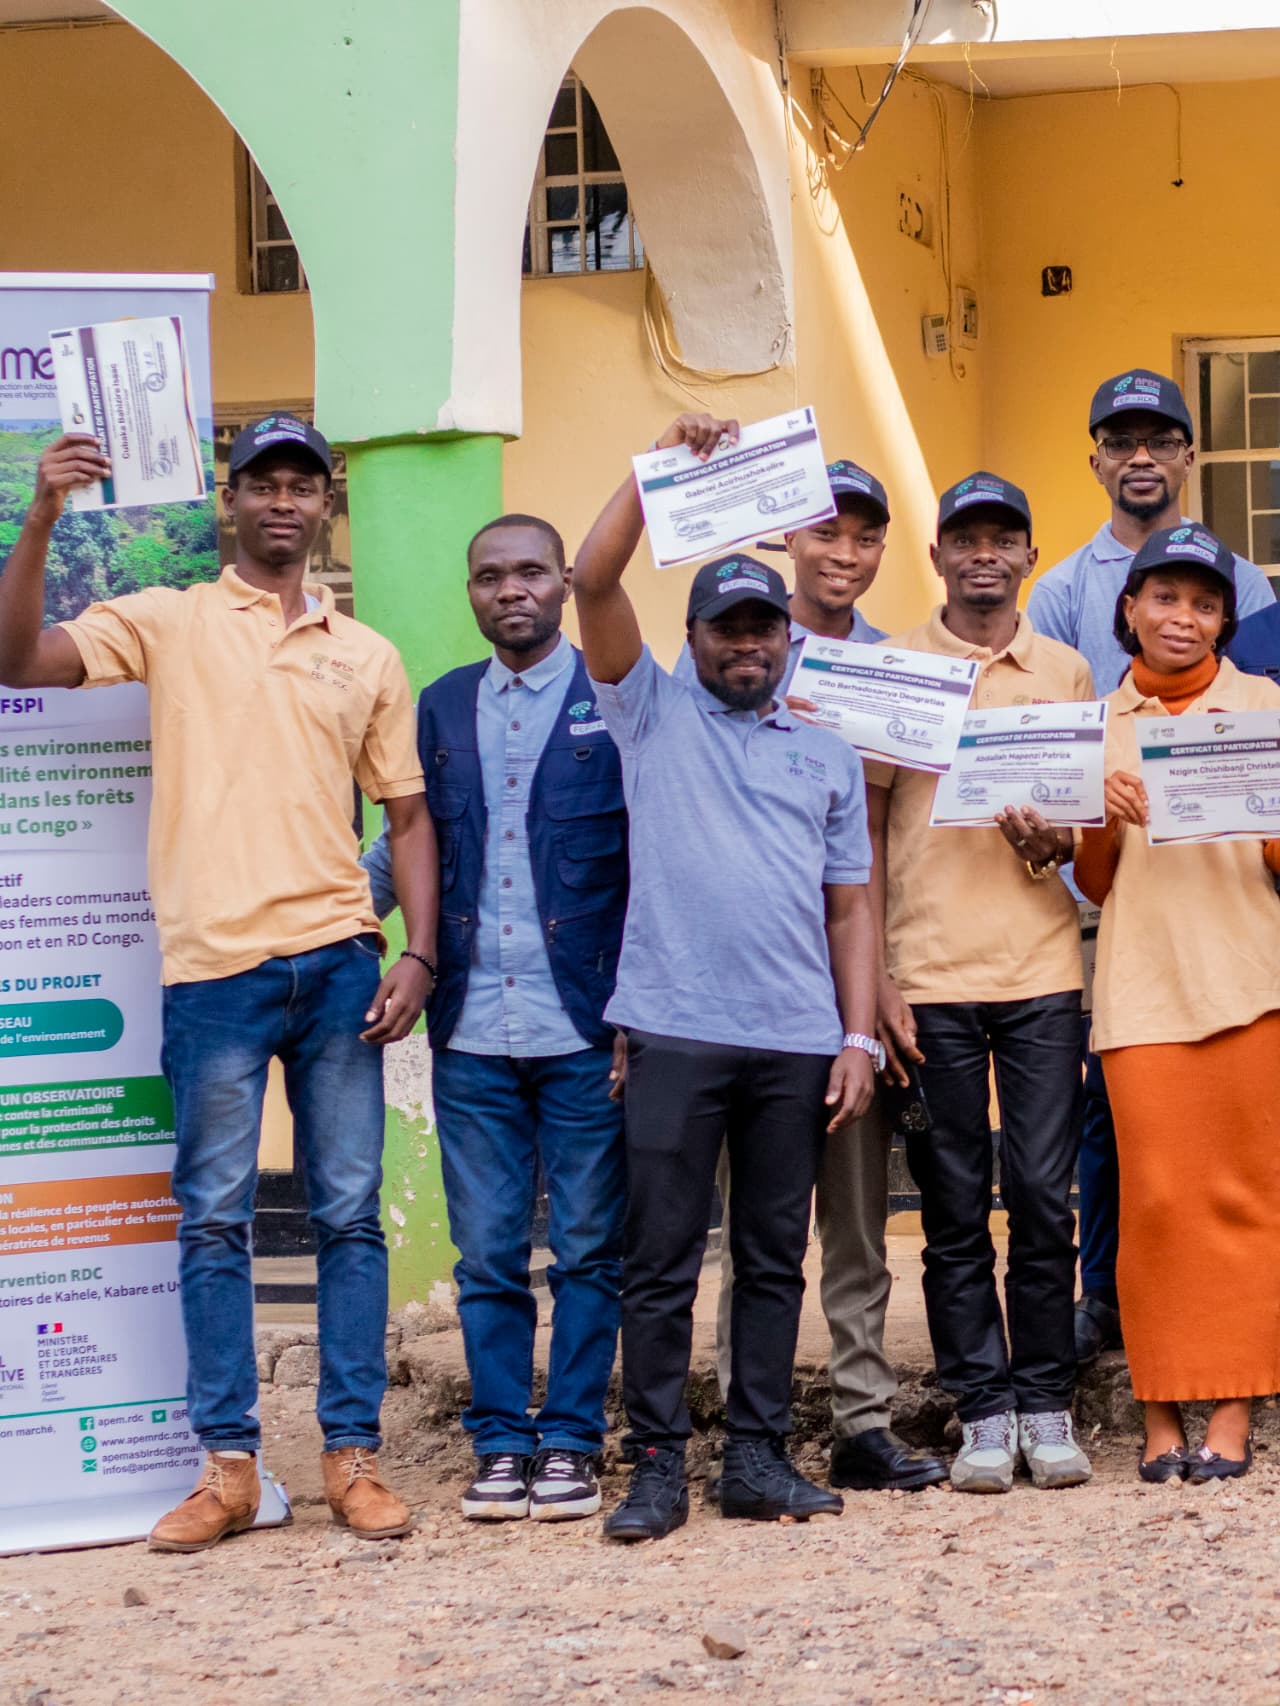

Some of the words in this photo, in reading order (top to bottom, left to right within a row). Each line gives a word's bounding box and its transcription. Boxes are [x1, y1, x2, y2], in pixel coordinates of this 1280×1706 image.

[1, 698, 43, 713] FSPI
[45, 791, 71, 806] les
[77, 789, 134, 805] forêts
[17, 818, 77, 837] Congo
[20, 915, 78, 928] femmes
[82, 912, 100, 925] du
[27, 937, 41, 949] et
[45, 938, 62, 948] en
[67, 934, 87, 946] RD
[92, 933, 143, 947] Congo.
[16, 978, 37, 991] DU
[42, 974, 102, 989] PROJET
[16, 1030, 106, 1043] l'environnement
[23, 1086, 125, 1103] OBSERVATOIRE
[5, 1109, 39, 1120] contre
[54, 1103, 113, 1117] criminalité
[2, 1126, 27, 1139] pour
[42, 1120, 99, 1136] protection
[101, 1118, 121, 1129] des
[122, 1116, 155, 1127] droits
[37, 1138, 56, 1148] des
[58, 1132, 136, 1147] communautés
[138, 1130, 176, 1141] locales
[11, 1204, 62, 1219] résilience
[64, 1202, 83, 1214] des
[86, 1200, 128, 1214] peuples
[8, 1223, 48, 1235] locales,
[51, 1222, 64, 1231] en
[67, 1216, 123, 1232] particulier
[125, 1214, 144, 1224] des
[51, 1235, 65, 1246] de
[67, 1233, 110, 1244] revenus
[71, 1268, 103, 1282] RDC
[37, 1293, 51, 1305] de
[55, 1289, 100, 1303] Kahele,
[105, 1284, 148, 1299] Kabare
[152, 1283, 164, 1294] et
[37, 1334, 89, 1347] MINISTÈRE
[38, 1350, 50, 1358] DE
[52, 1345, 97, 1357] L'EUROPE
[39, 1361, 50, 1369] ET
[53, 1358, 71, 1368] DES
[73, 1353, 117, 1366] AFFAIRES
[98, 1414, 144, 1427] apem.rdc
[101, 1430, 189, 1447] www.apemrdc.org
[103, 1457, 199, 1475] infos@apemrdc.org
